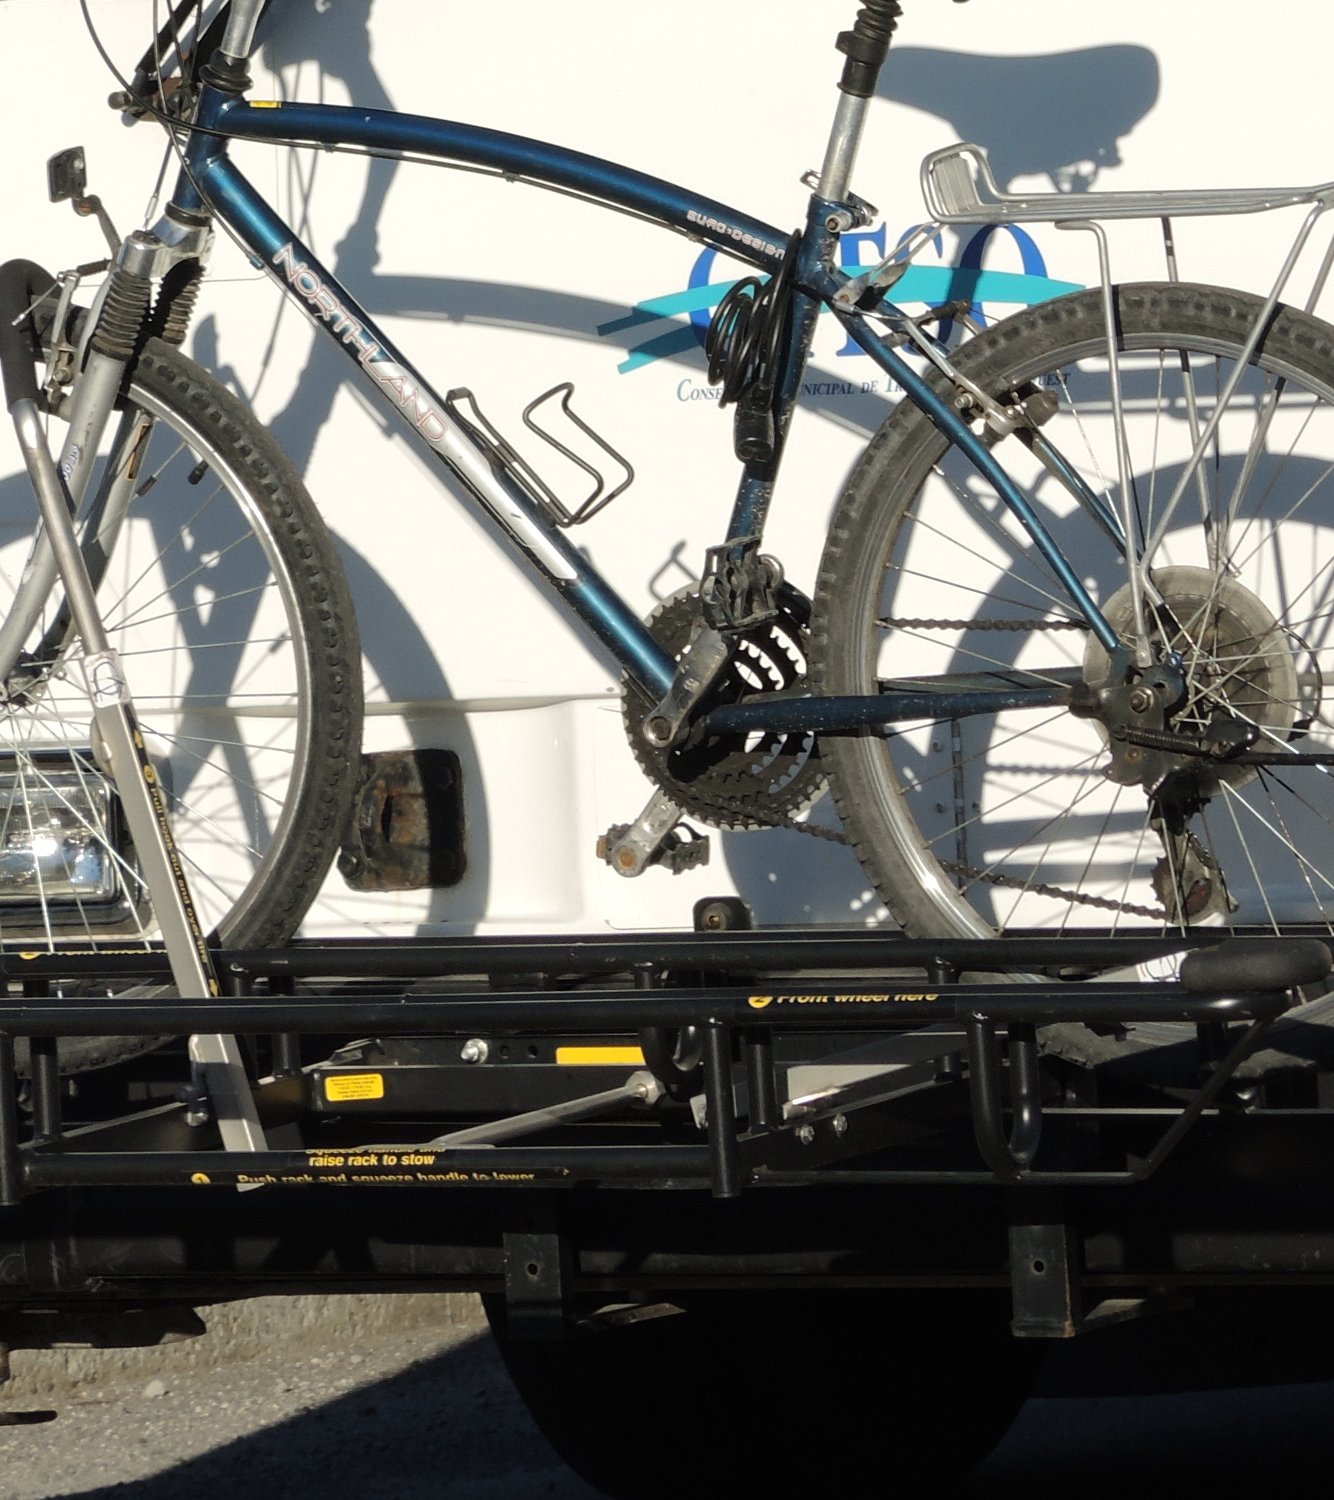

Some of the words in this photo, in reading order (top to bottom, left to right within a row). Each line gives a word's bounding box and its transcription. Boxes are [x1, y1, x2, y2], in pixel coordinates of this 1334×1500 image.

[271, 241, 449, 443] NORTHLAND
[308, 1154, 345, 1167] raise
[347, 1153, 379, 1167] rack
[381, 1153, 398, 1166] to
[400, 1154, 436, 1166] stow
